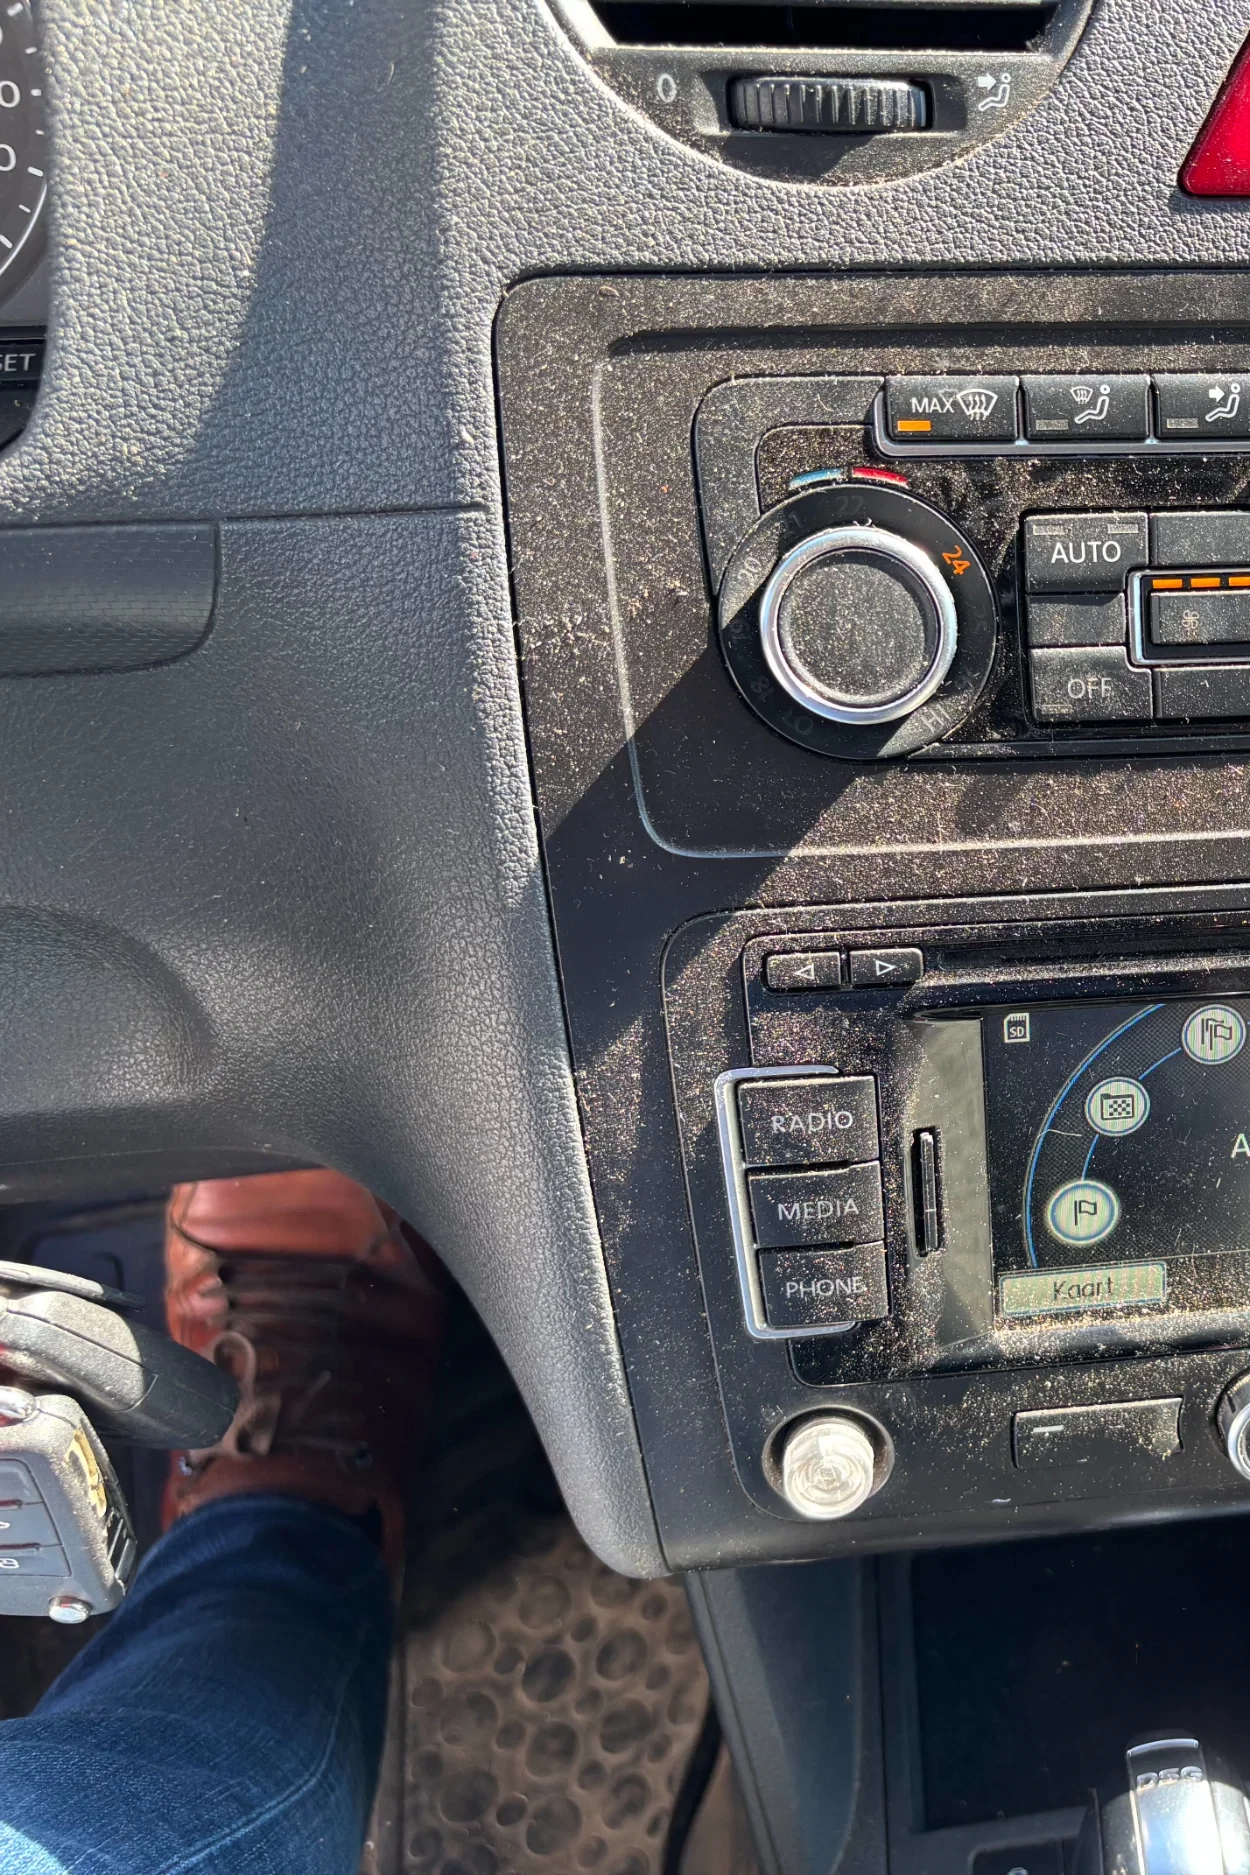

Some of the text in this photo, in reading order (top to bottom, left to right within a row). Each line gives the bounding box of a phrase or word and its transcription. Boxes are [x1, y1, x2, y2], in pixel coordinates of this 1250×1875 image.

[911, 396, 954, 413] MAX
[941, 545, 971, 576] 24
[1051, 540, 1121, 564] AUTO
[1067, 678, 1113, 700] OFF
[1009, 1026, 1025, 1037] SD
[771, 1110, 853, 1133] RADIO
[778, 1199, 859, 1221] MEDIA
[786, 1276, 866, 1299] PHONE
[1052, 1276, 1116, 1301] Kaart
[1136, 1766, 1203, 1792] DSG
